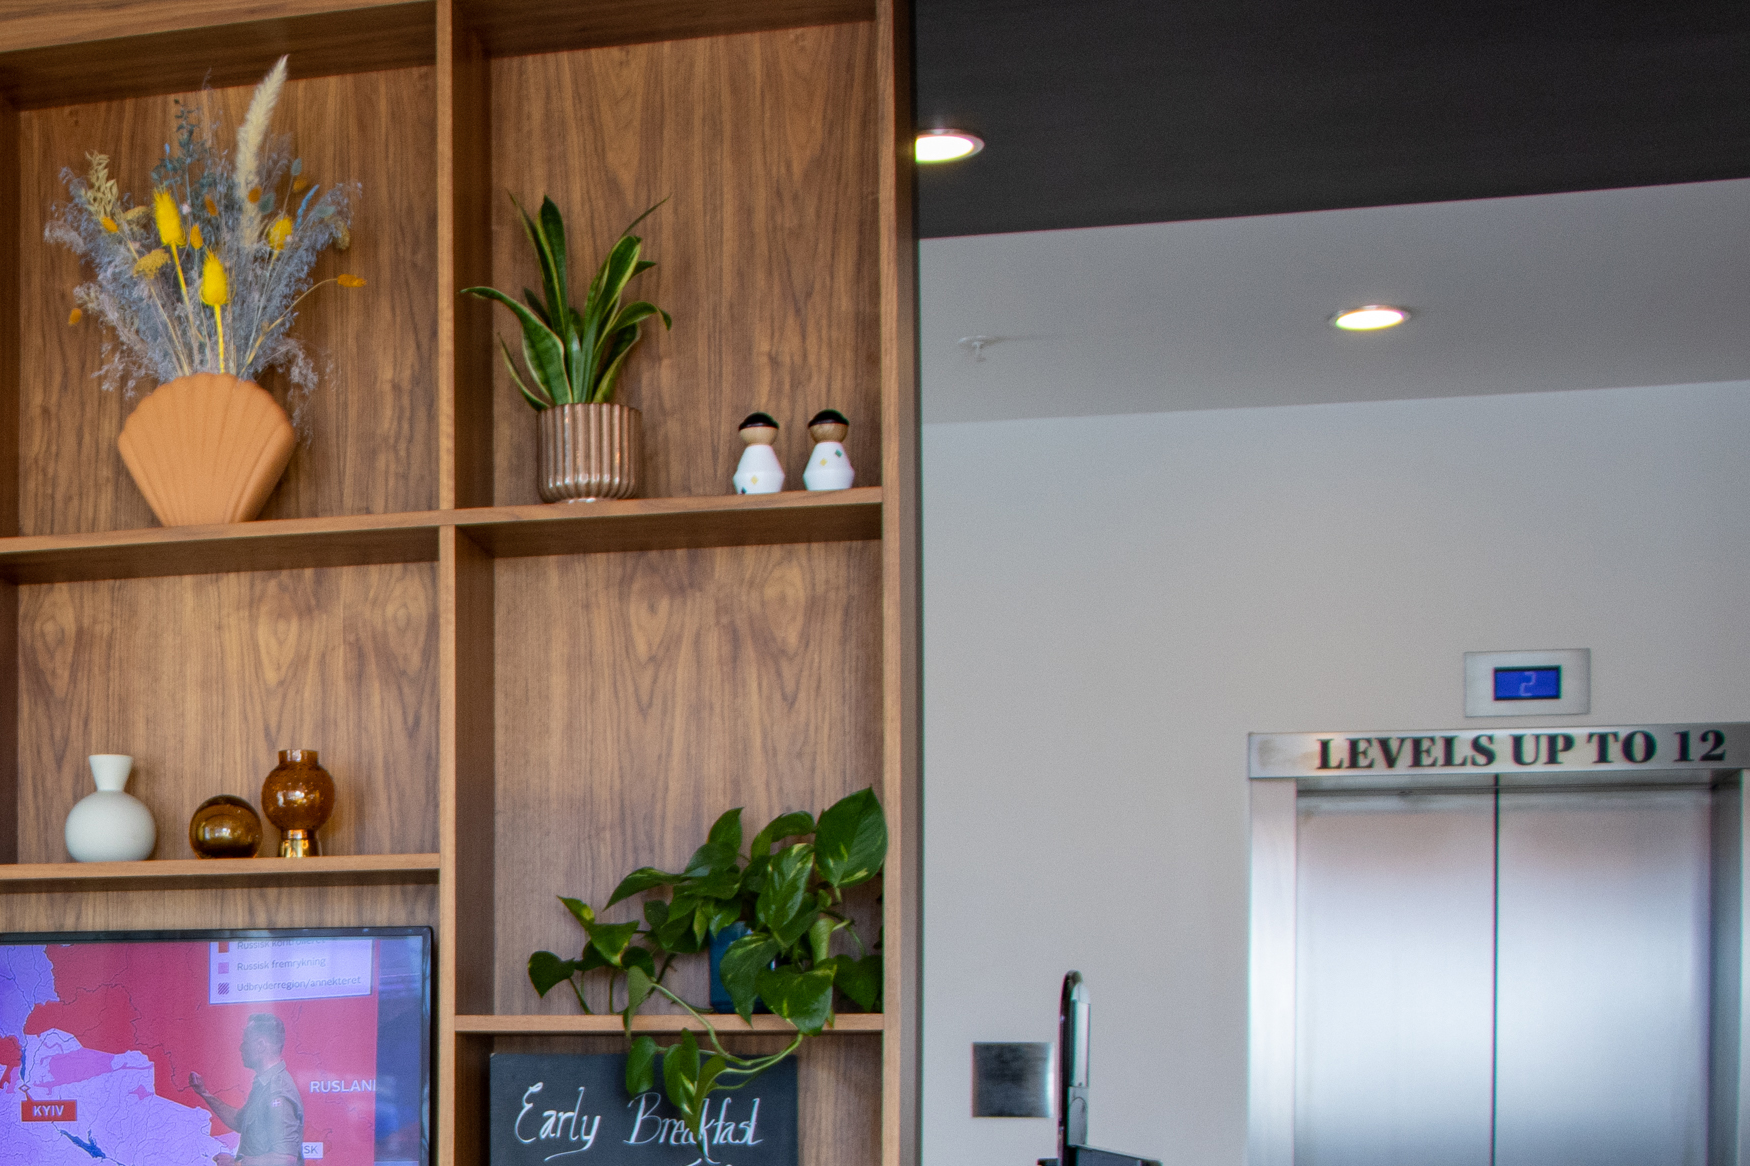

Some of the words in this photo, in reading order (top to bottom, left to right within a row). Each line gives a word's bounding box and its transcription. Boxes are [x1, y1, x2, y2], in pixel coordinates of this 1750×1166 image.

[1519, 671, 1536, 696] 2
[1316, 734, 1496, 770] LEVELS
[1510, 731, 1576, 766] UP
[1587, 729, 1658, 764] TO
[1673, 729, 1727, 762] 12
[237, 962, 270, 971] Russisk
[309, 1079, 376, 1094] RUSLAN
[33, 1105, 65, 1117] KYIV
[514, 1081, 601, 1161] Early
[623, 1091, 764, 1165] Breakfast
